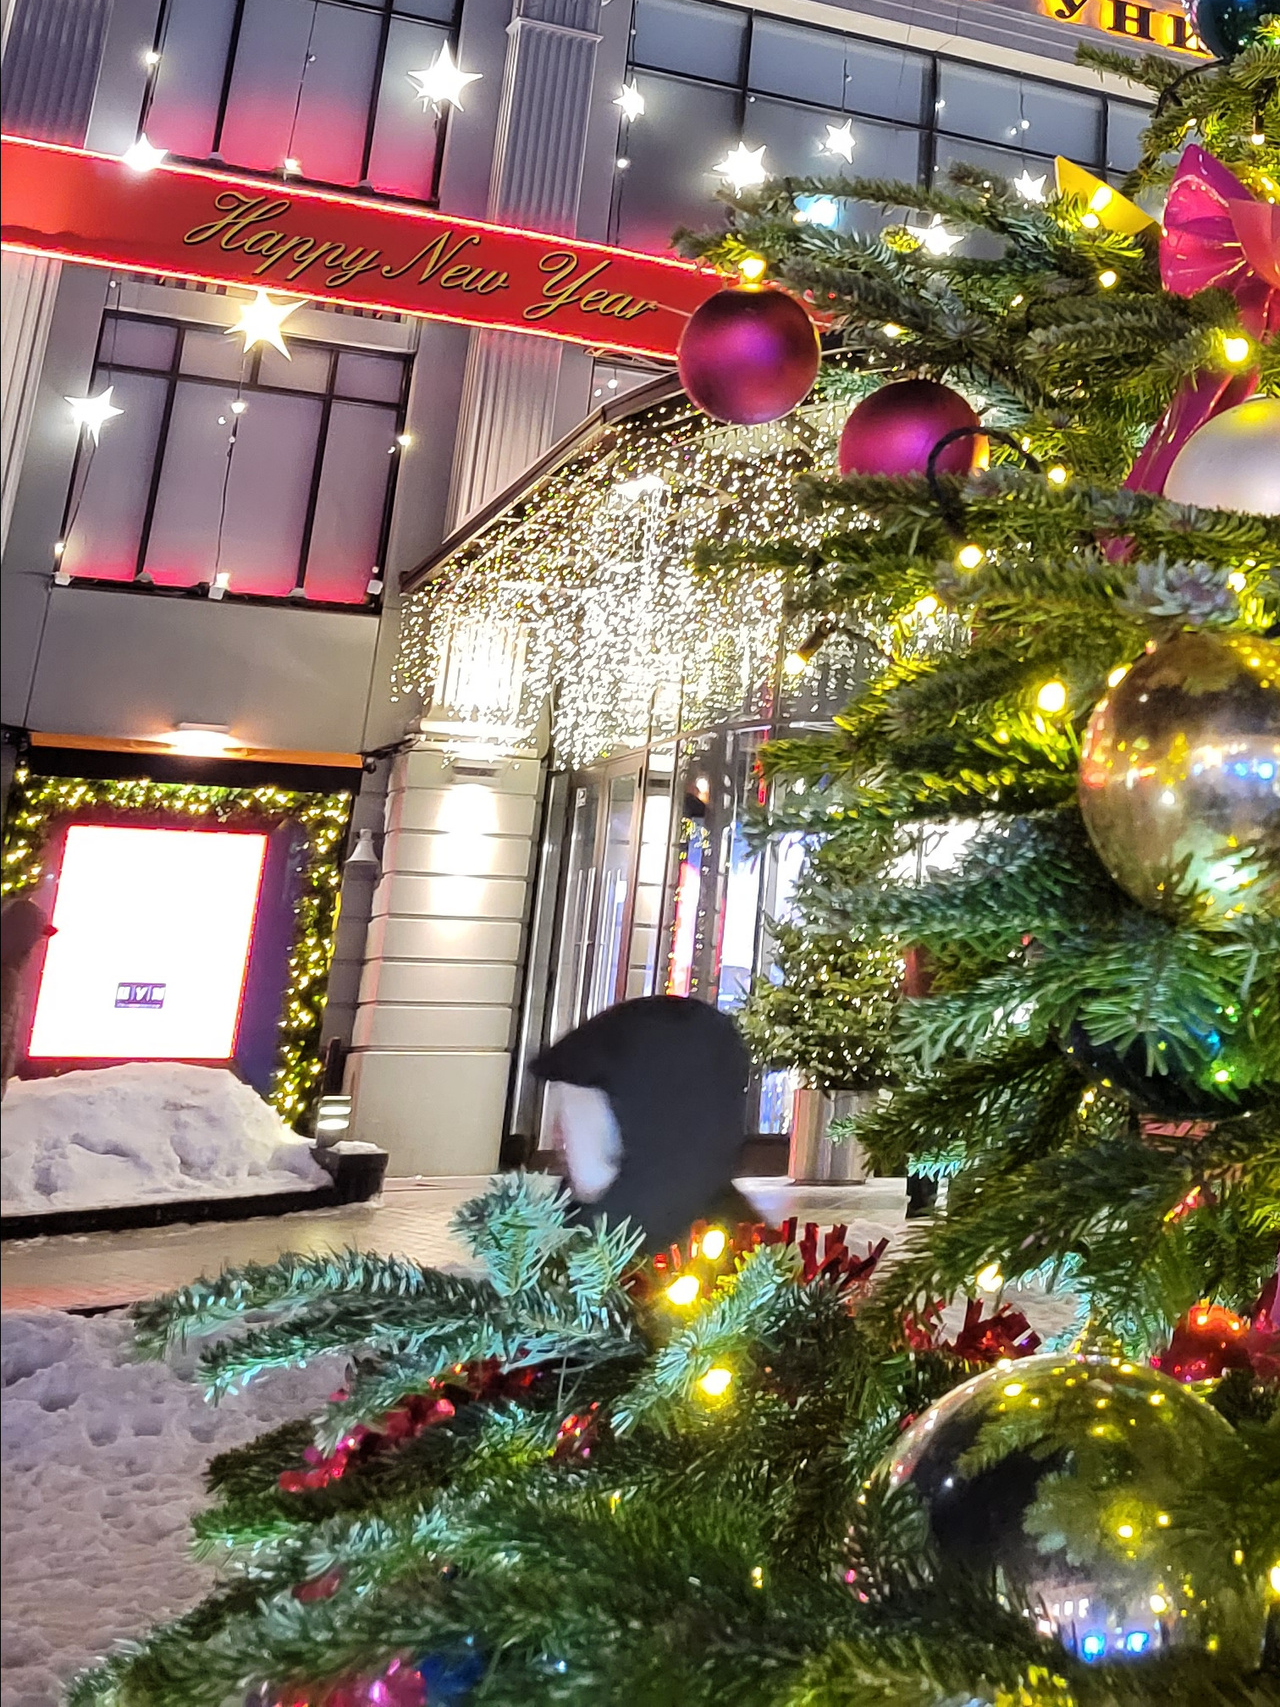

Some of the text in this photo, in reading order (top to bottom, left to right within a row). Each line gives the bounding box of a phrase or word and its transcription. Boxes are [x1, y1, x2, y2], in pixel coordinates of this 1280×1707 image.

[183, 191, 657, 321] Happy New Year
